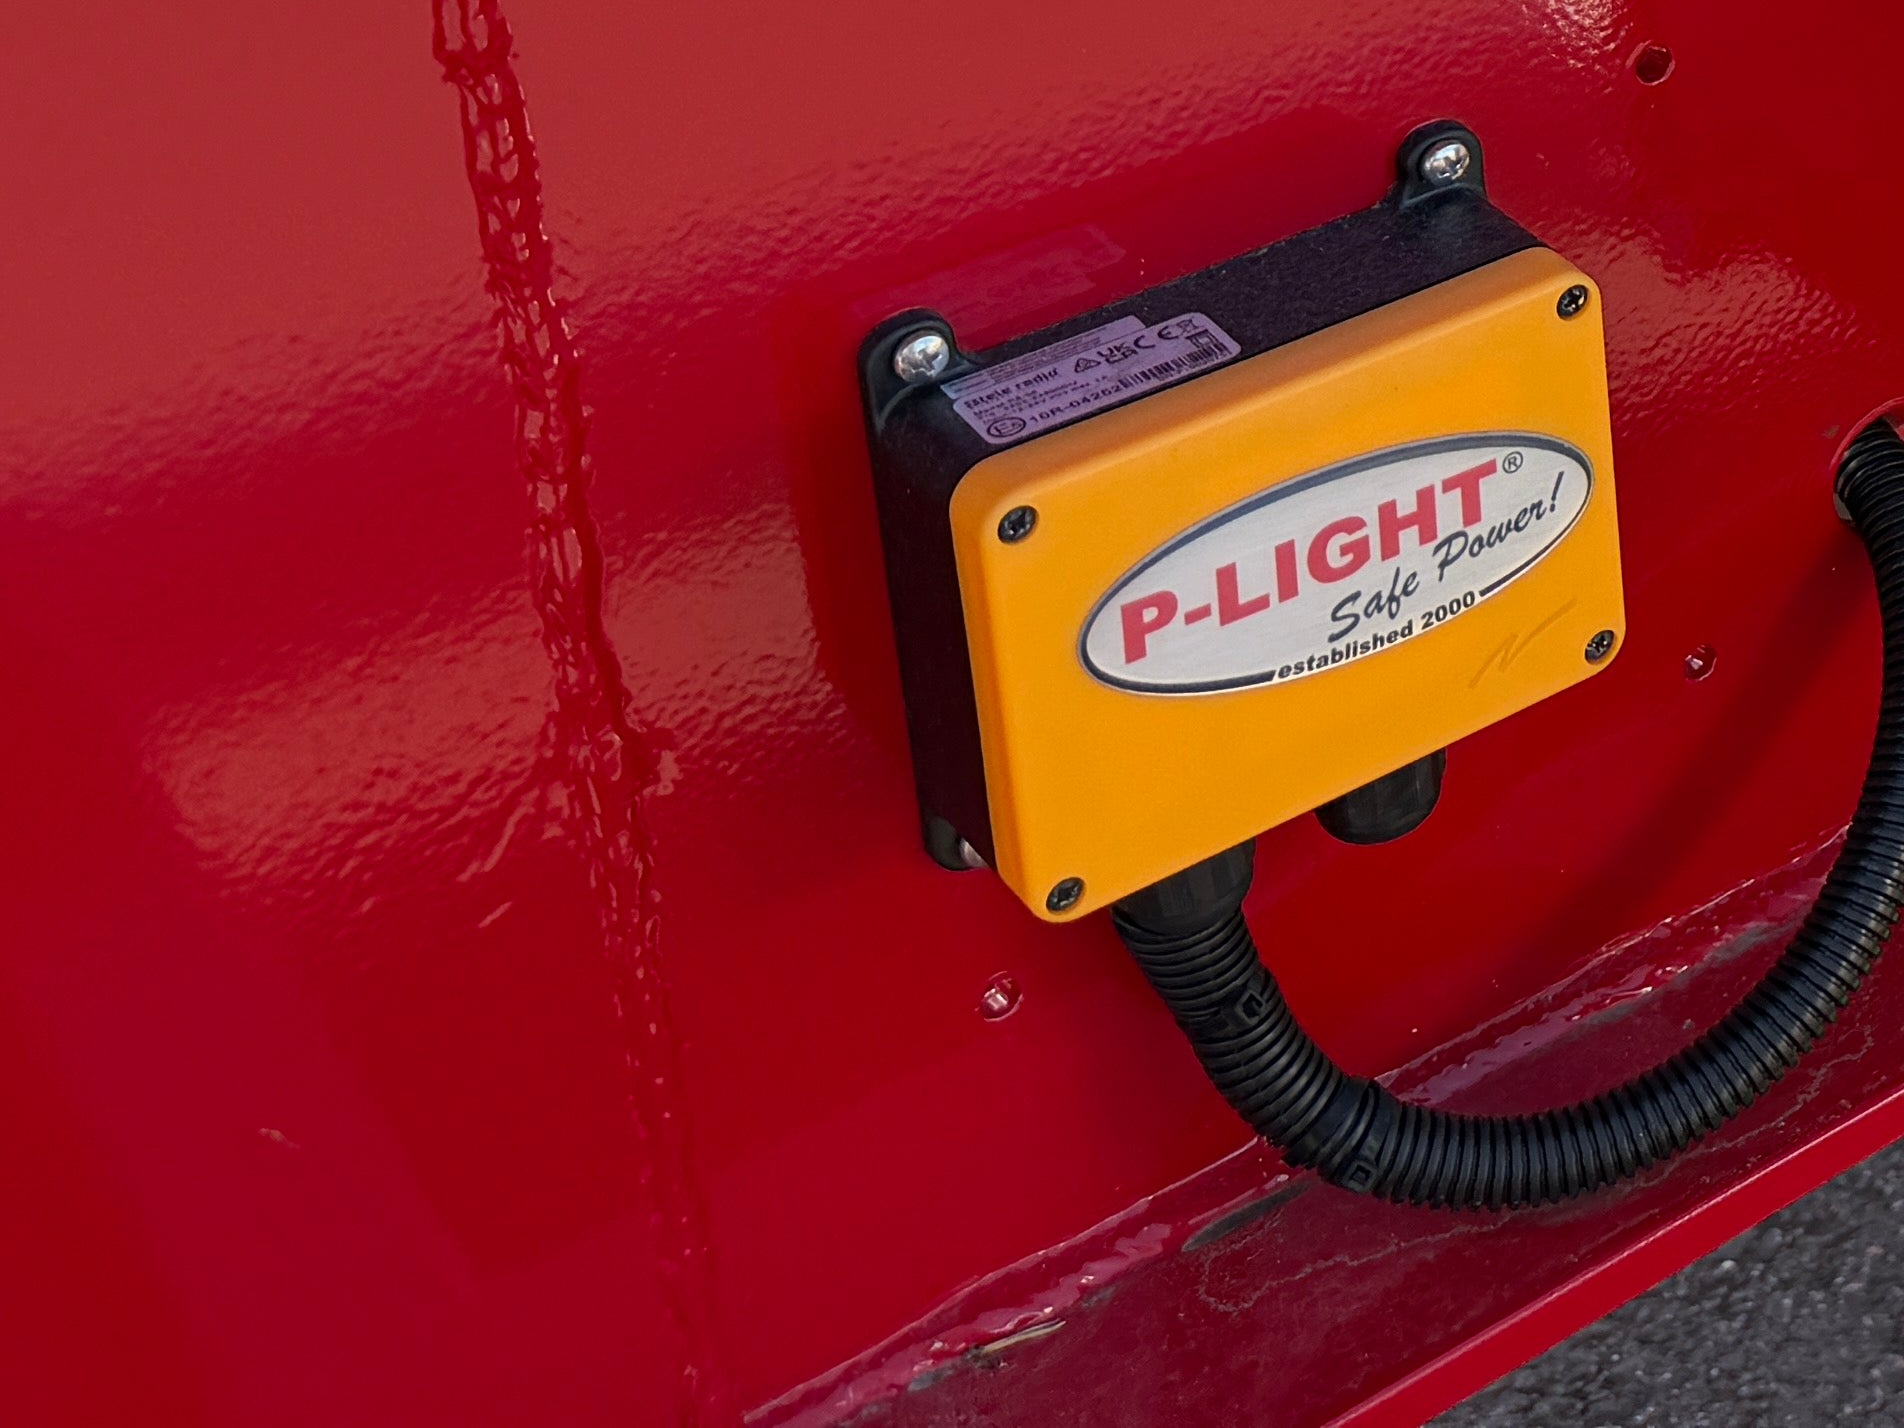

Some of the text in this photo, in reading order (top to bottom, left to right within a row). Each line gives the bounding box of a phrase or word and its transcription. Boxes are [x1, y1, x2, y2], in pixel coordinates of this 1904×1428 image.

[1328, 471, 1566, 643] Safe Power!
[1276, 590, 1477, 680] established 2000
